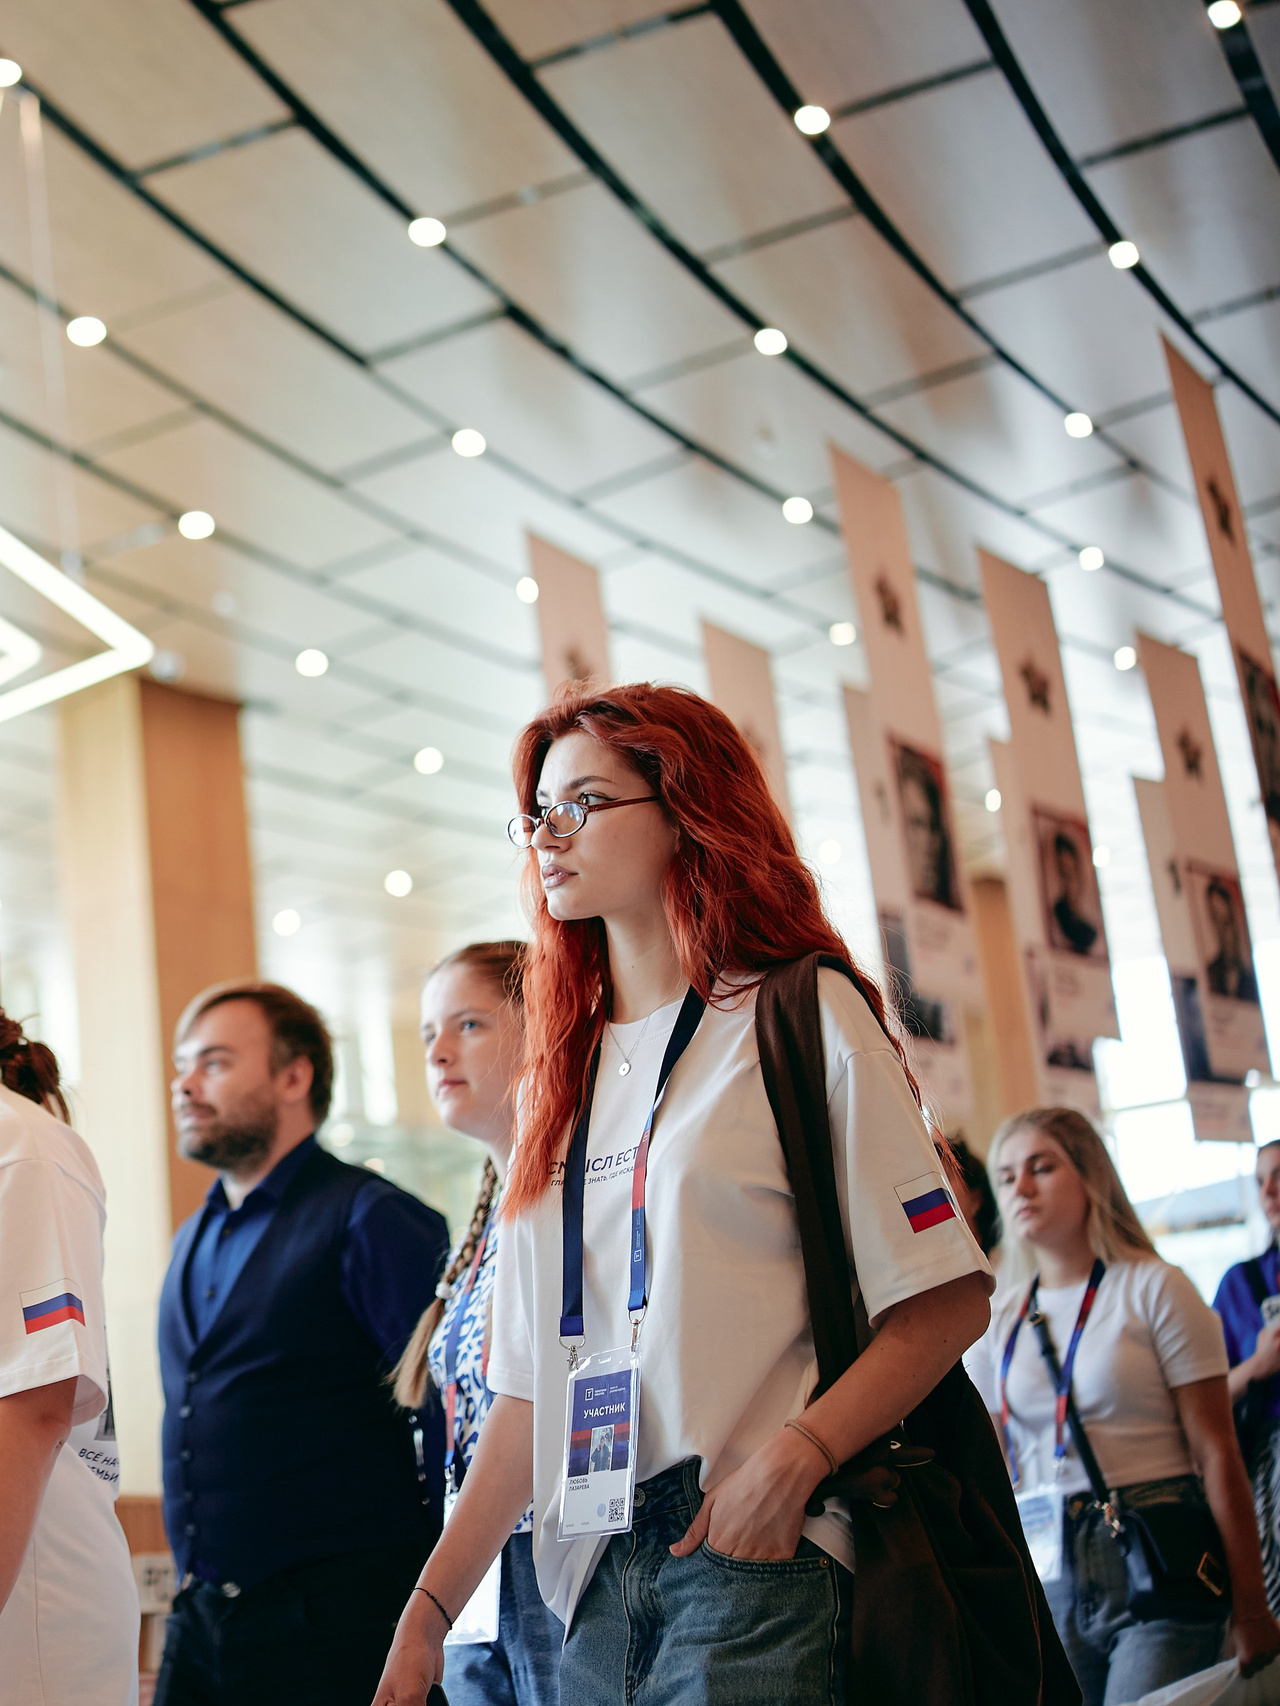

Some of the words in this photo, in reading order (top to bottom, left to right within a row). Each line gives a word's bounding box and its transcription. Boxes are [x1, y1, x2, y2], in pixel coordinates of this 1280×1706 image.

[583, 1402, 626, 1419] УЧАСТНИК
[78, 1448, 104, 1462] ВСЁ
[101, 1456, 119, 1467] НА
